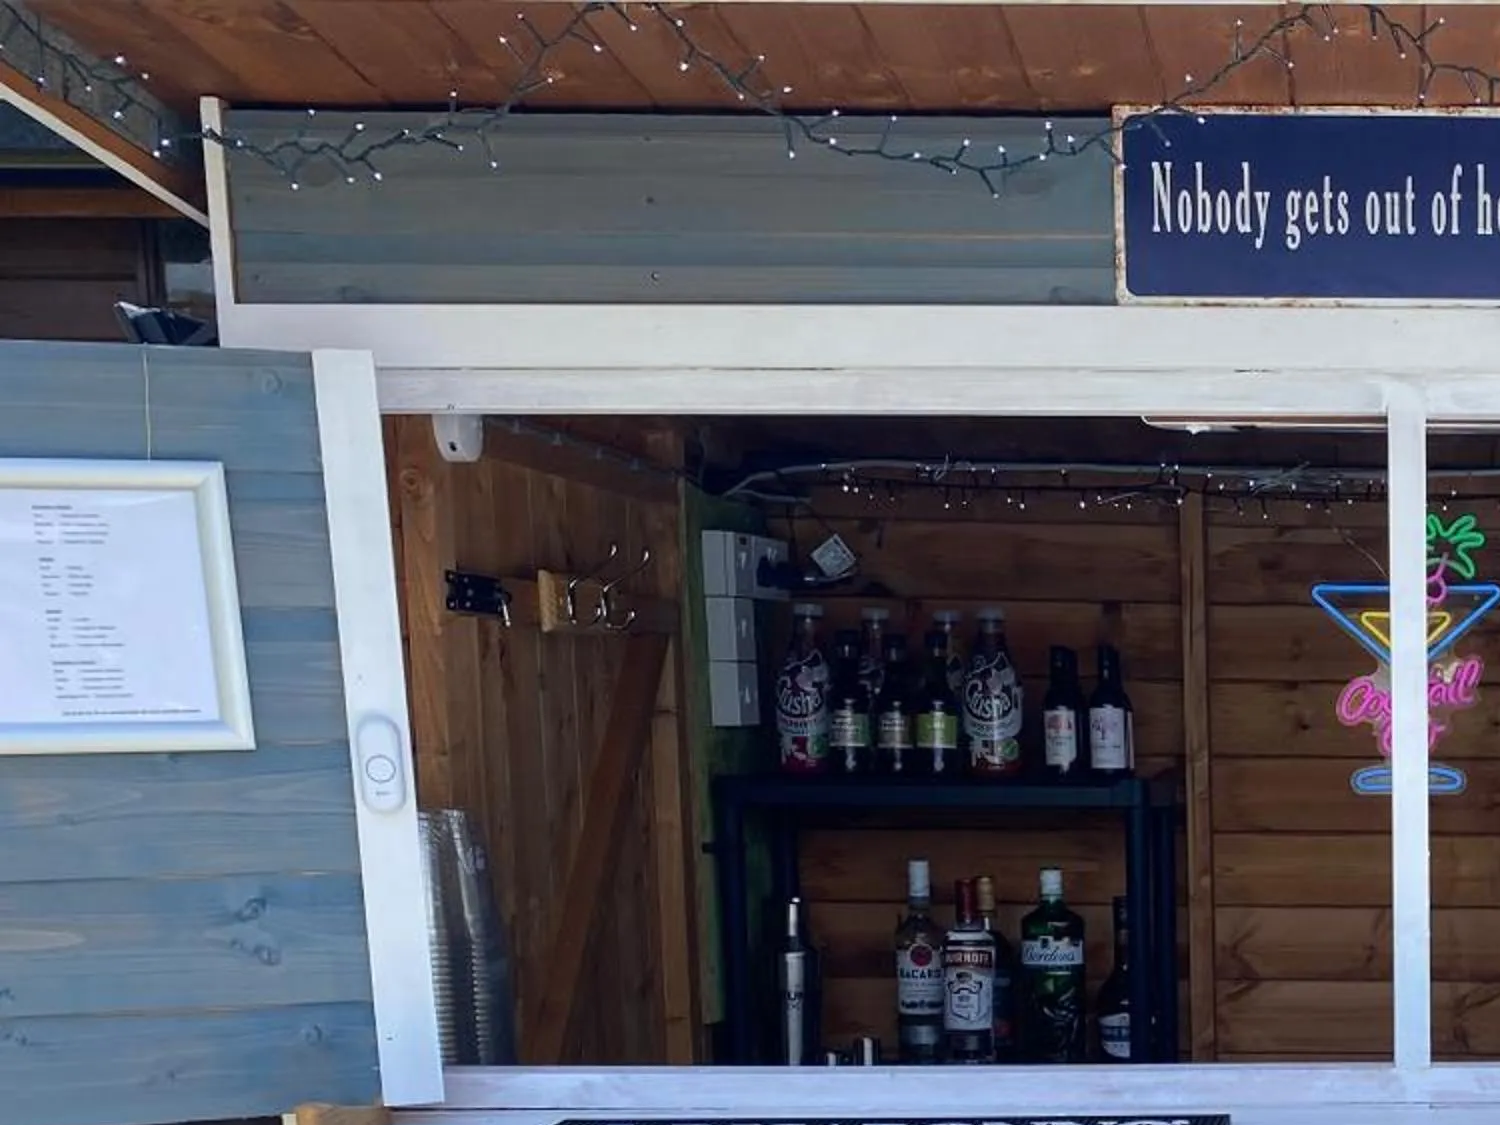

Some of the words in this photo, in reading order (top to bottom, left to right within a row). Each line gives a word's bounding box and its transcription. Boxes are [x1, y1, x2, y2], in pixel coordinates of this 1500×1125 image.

[1151, 161, 1270, 250] Nobody
[1286, 176, 1350, 251] gets
[1366, 175, 1416, 236] out
[1431, 163, 1464, 236] of
